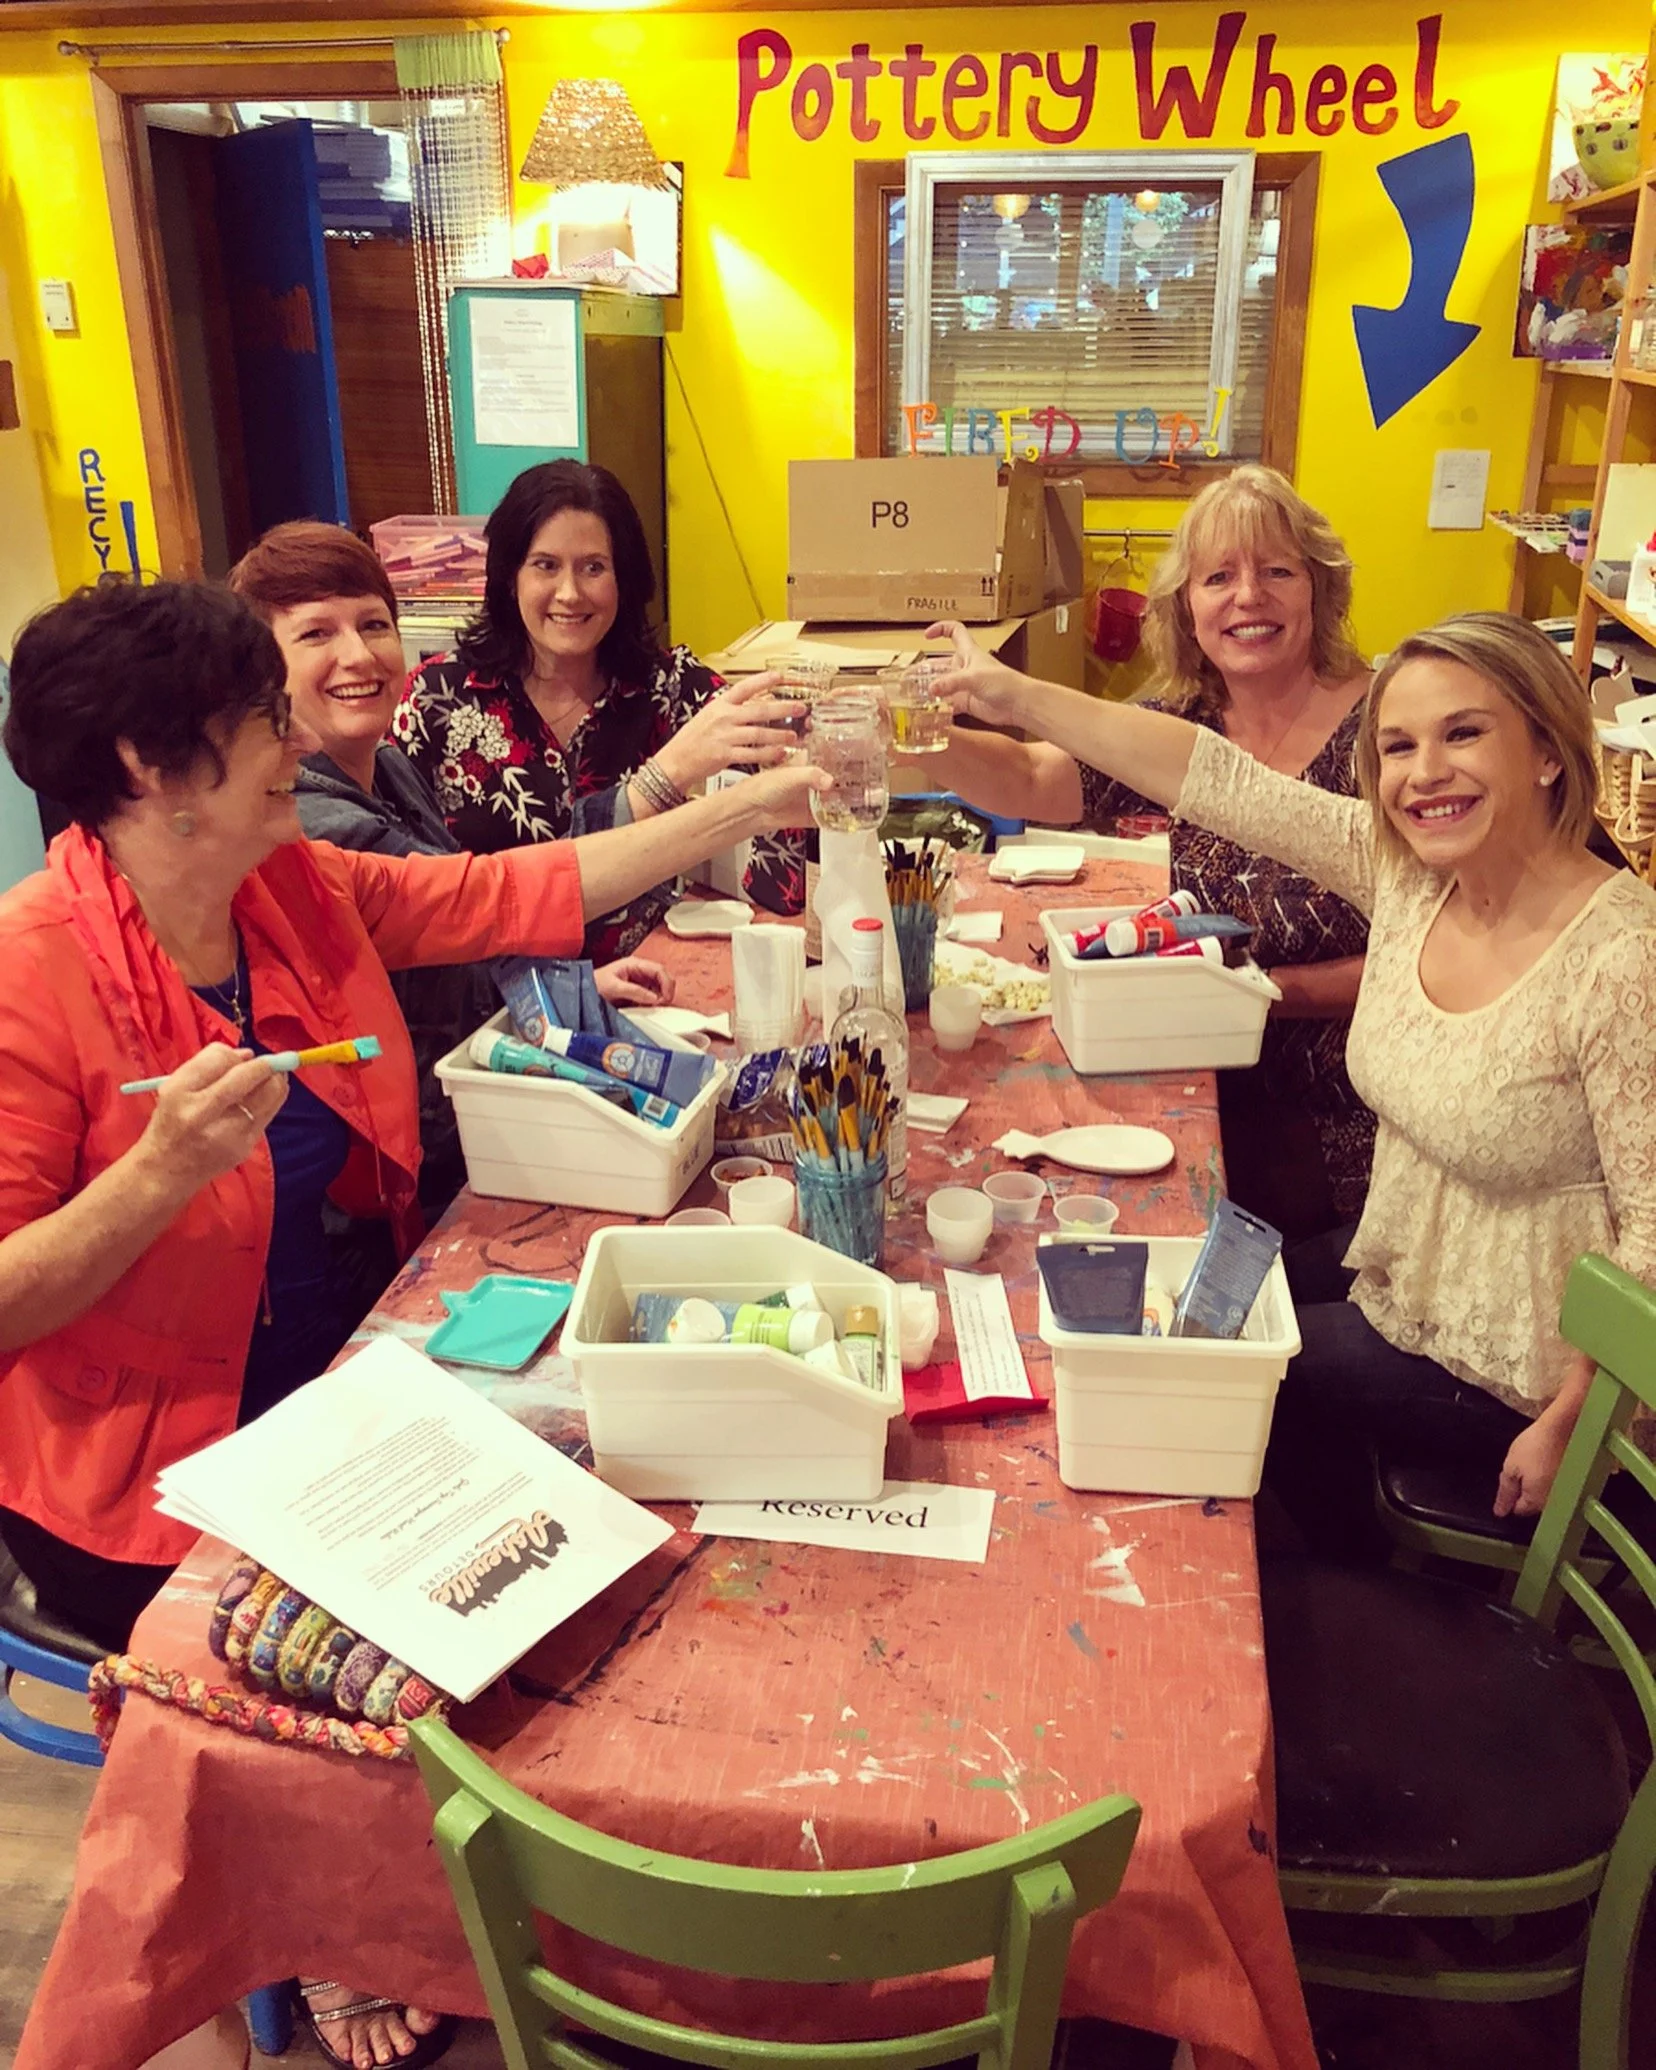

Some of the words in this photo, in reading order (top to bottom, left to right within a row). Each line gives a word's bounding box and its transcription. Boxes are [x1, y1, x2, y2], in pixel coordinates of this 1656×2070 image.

[724, 28, 1100, 179] Pottery
[1129, 11, 1461, 140] Wheel
[903, 402, 1083, 466] FIRED
[1115, 386, 1234, 470] UP!
[78, 448, 111, 571] RECY
[871, 500, 910, 528] P8
[907, 597, 959, 612] FRAGILE
[418, 1550, 476, 1592] DETOURS
[429, 1509, 552, 1605] Asheville
